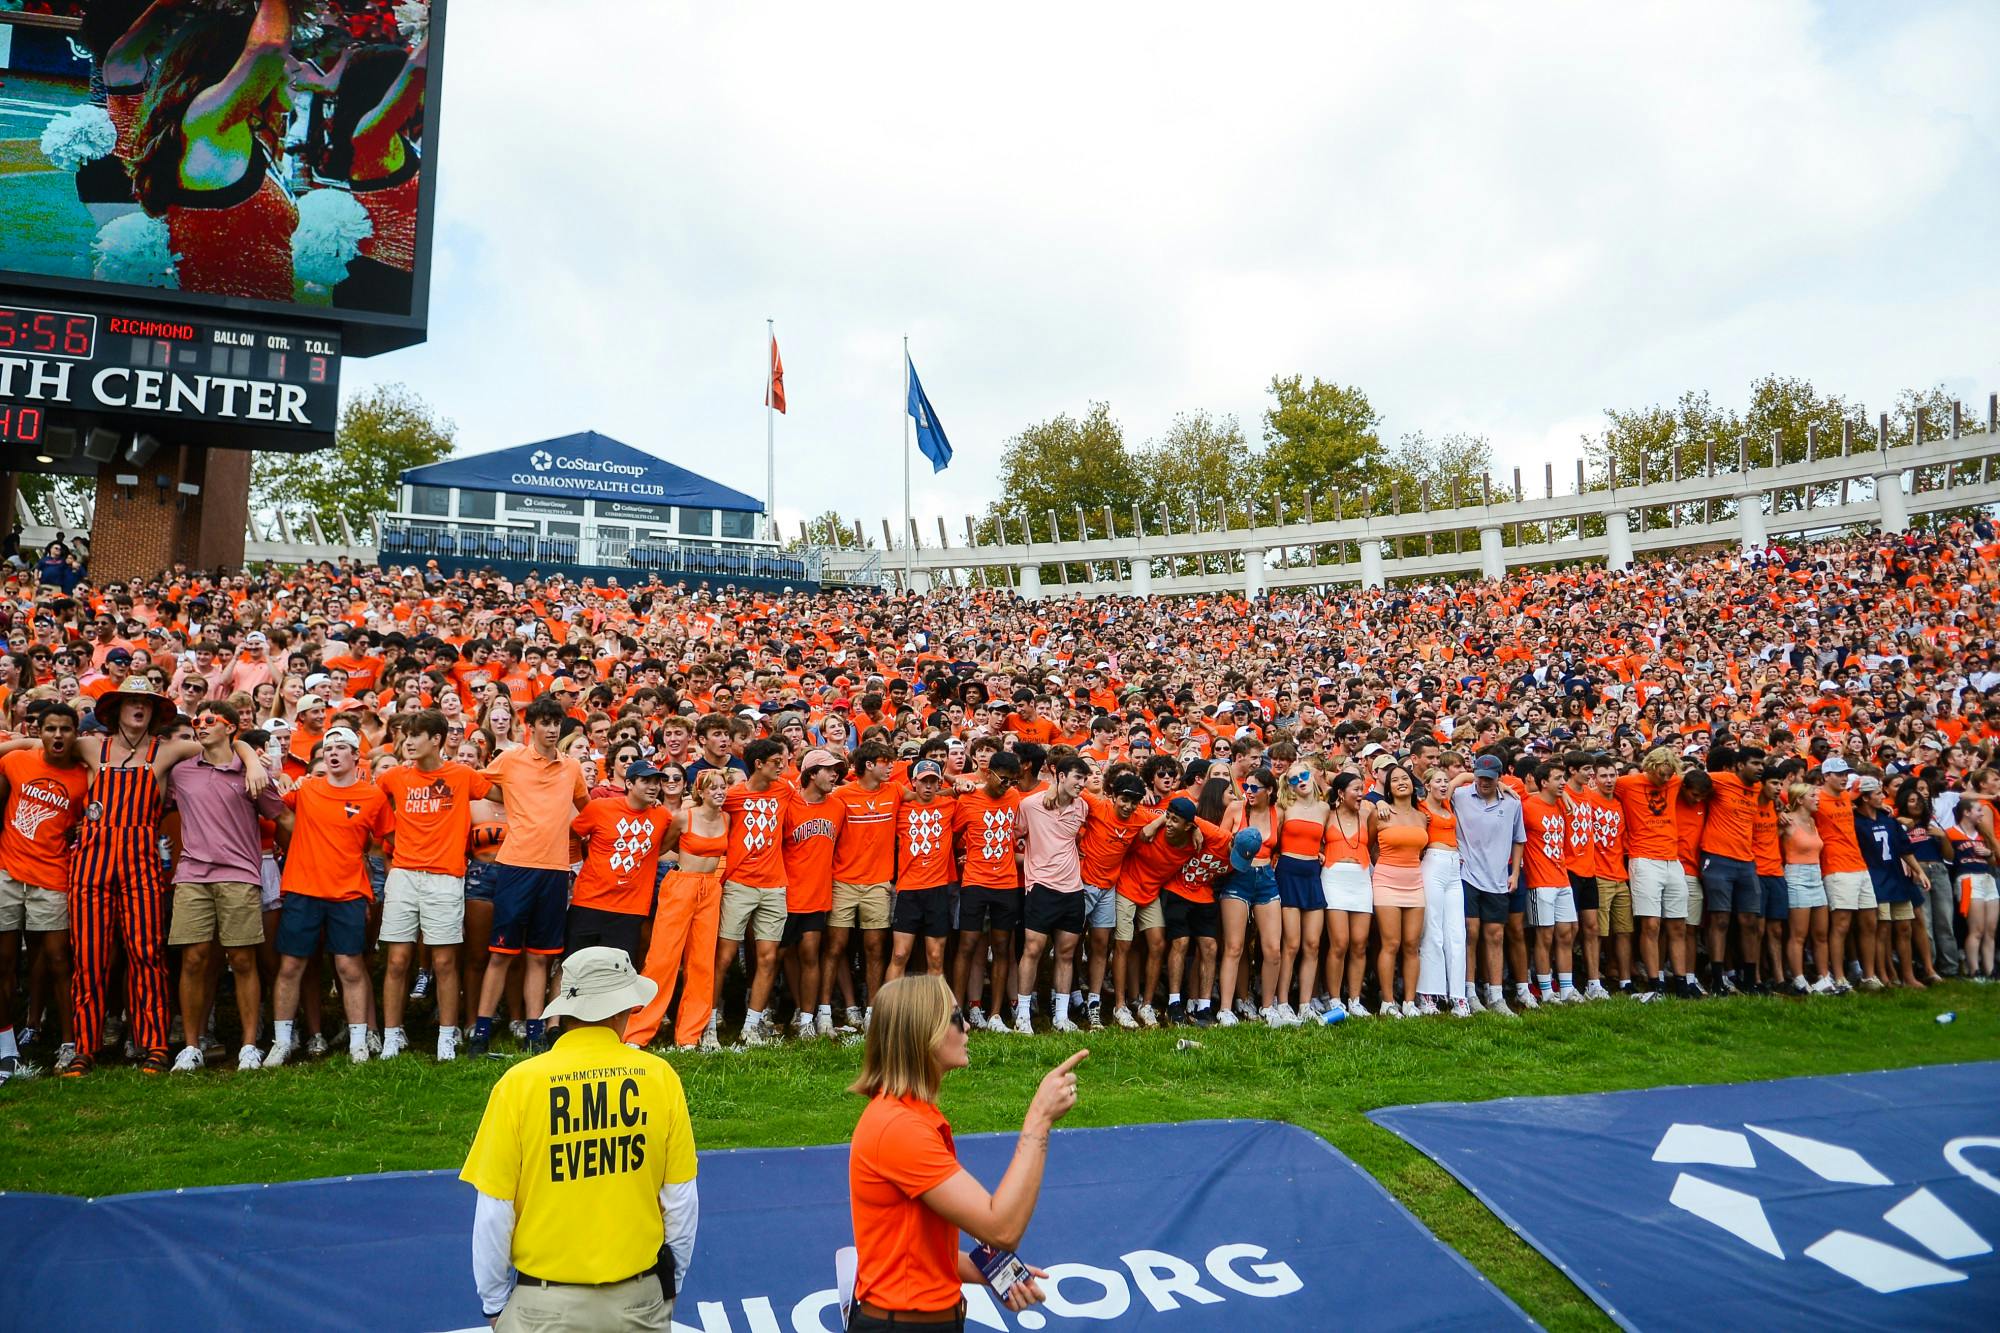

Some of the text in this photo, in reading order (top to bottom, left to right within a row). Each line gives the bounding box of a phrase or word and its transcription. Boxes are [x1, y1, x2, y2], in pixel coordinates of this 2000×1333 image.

[110, 317, 193, 341] RICHMOND
[213, 330, 255, 347] BALL ON
[267, 336, 290, 350] QTR.
[304, 340, 334, 355] T.O.L.
[311, 356, 326, 382] 3
[91, 367, 312, 424] CENTER
[511, 473, 665, 496] COMMONWEALTH CLUB
[21, 783, 70, 810] VIRGINIA
[405, 799, 441, 813] CREW
[1873, 831, 1892, 861] 7
[550, 1066, 646, 1084] www.RMCEVENTS.com
[550, 1077, 648, 1136] R.M.C.
[550, 1133, 646, 1182] EVENTS
